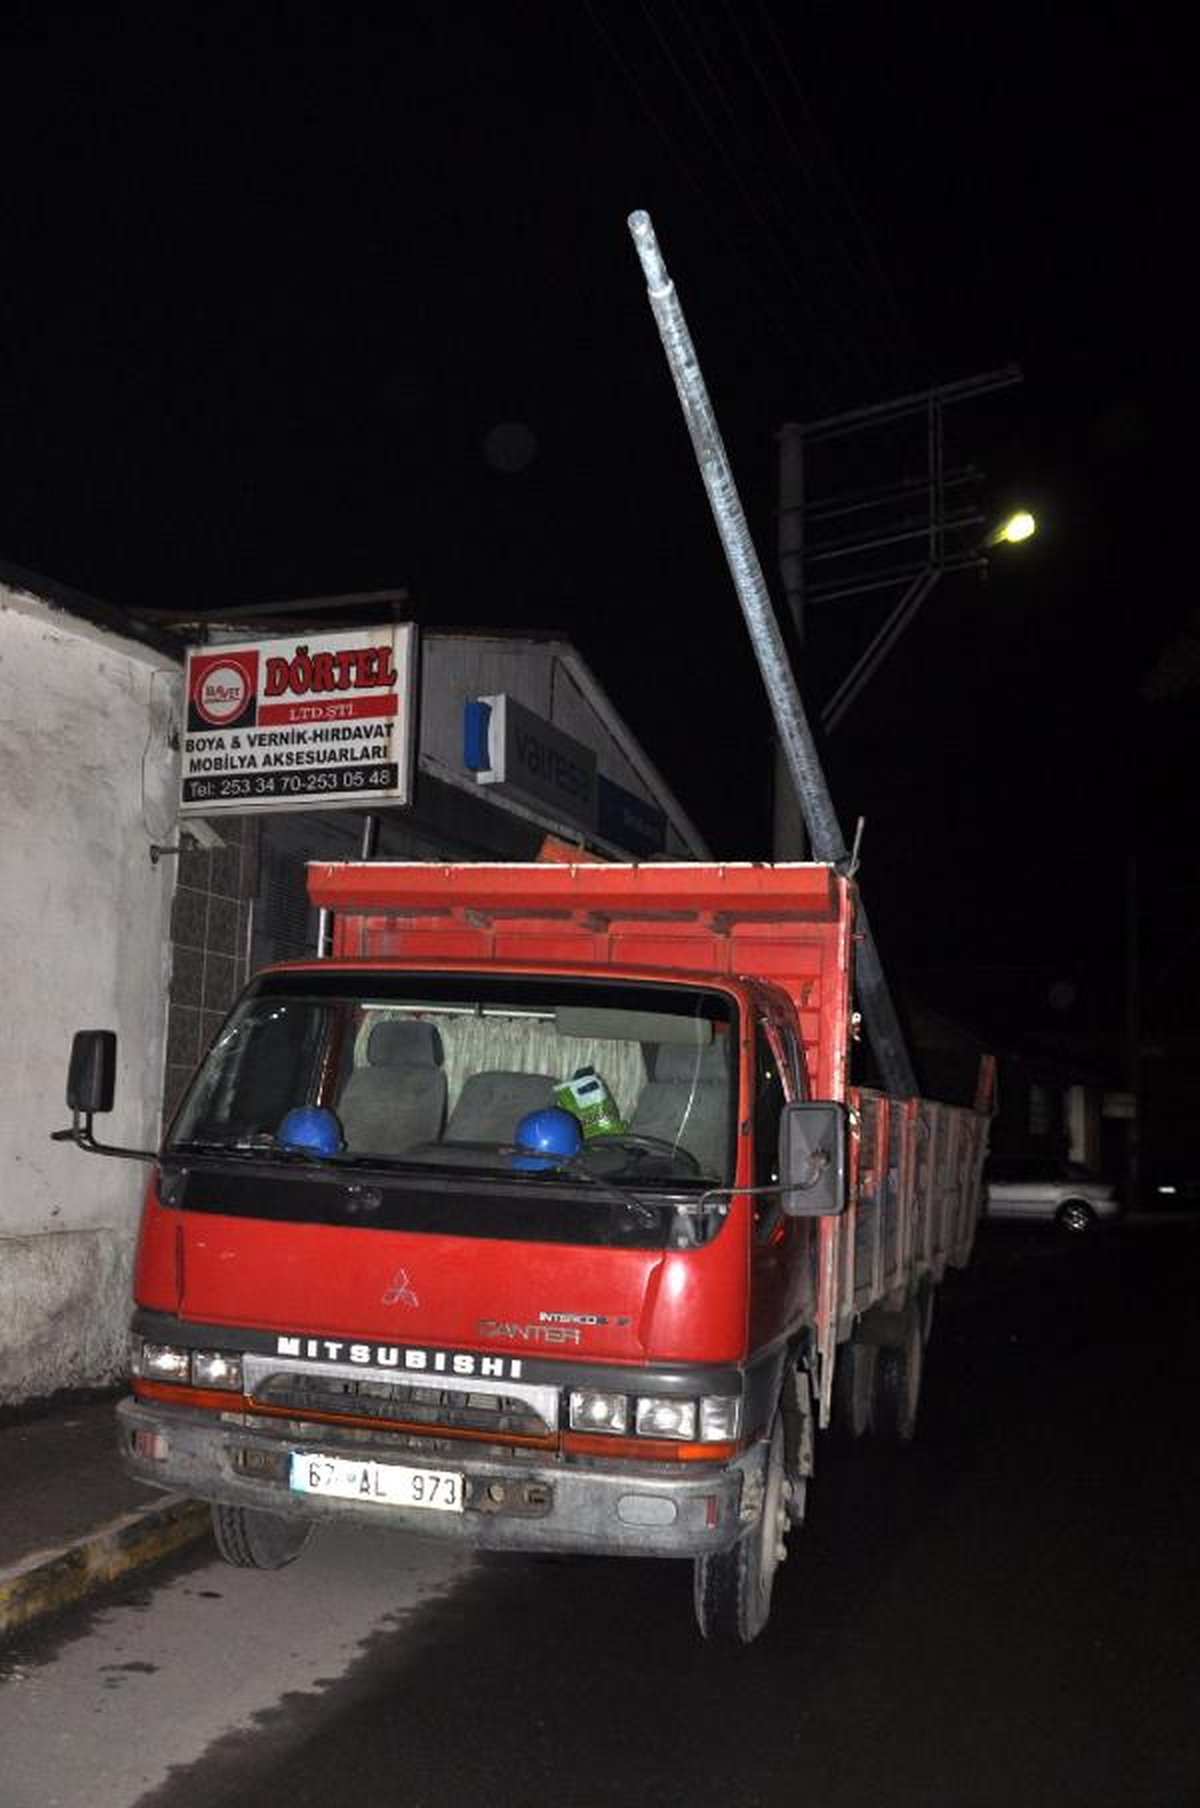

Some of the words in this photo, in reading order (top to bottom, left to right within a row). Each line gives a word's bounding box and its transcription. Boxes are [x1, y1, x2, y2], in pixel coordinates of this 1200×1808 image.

[264, 645, 397, 696] DÖRTEL
[185, 736, 230, 753] BOYA
[231, 736, 241, 749] &
[247, 723, 395, 747] VERNİK-HIRDAVAT
[189, 752, 257, 773] MOBİLYA
[262, 745, 390, 767] AKSESUARLARI
[221, 777, 251, 796] 253
[255, 777, 274, 794] 34
[281, 773, 338, 792] 70-253
[343, 771, 364, 787] 05
[369, 769, 391, 786] 48
[479, 1319, 582, 1346] CANTER
[277, 1337, 522, 1377] MITSUBISHI
[359, 1468, 387, 1496] AL
[412, 1475, 457, 1505] 973
